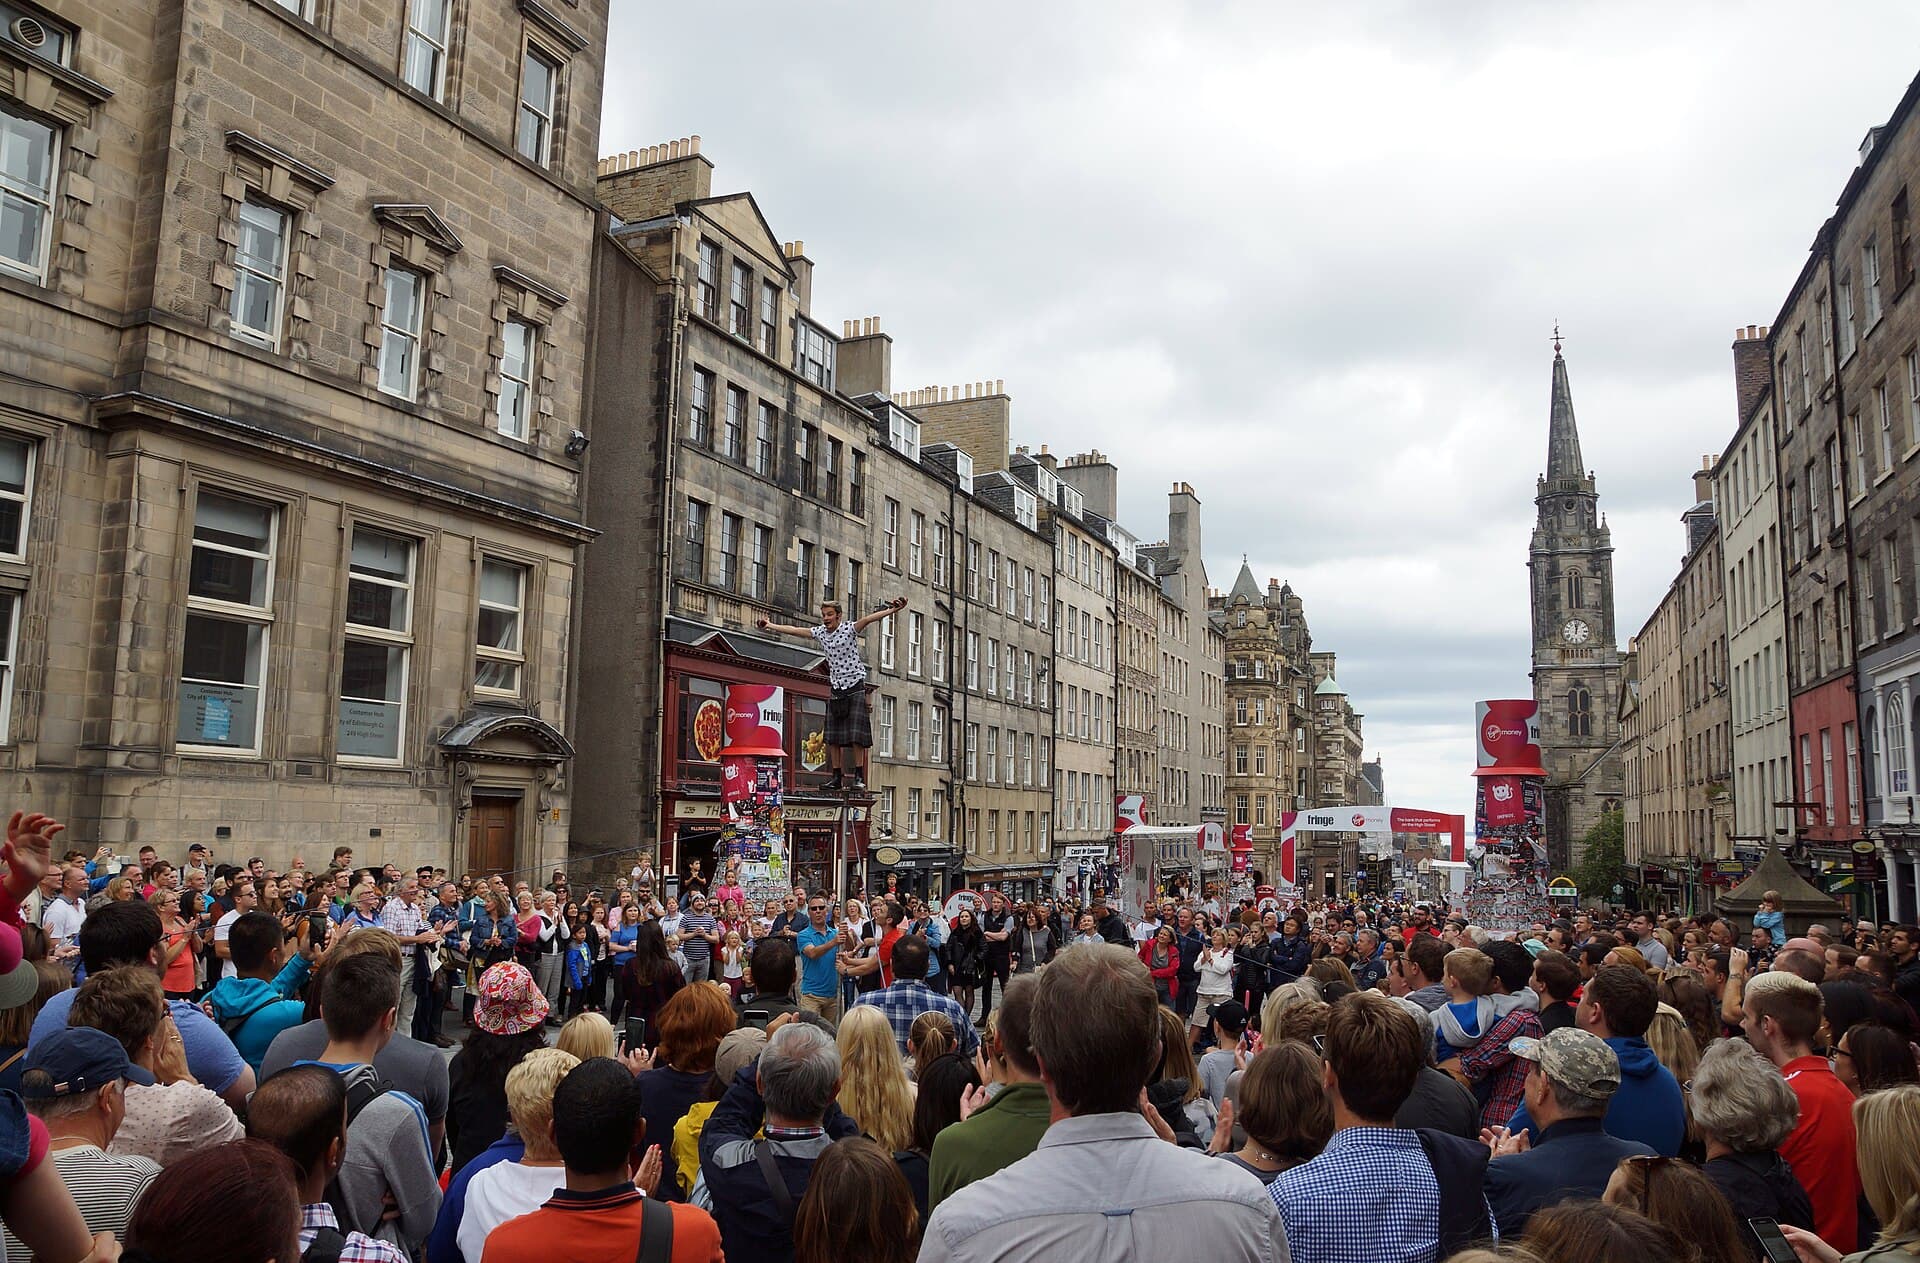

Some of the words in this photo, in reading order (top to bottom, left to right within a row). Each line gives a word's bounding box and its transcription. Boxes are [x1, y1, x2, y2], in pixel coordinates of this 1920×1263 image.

[763, 709, 782, 724] fring
[1502, 728, 1521, 736] money
[1531, 725, 1540, 738] fri
[706, 805, 720, 816] TH
[785, 808, 819, 819] STATION
[1119, 807, 1135, 815] fringe
[1307, 814, 1334, 827] fringe
